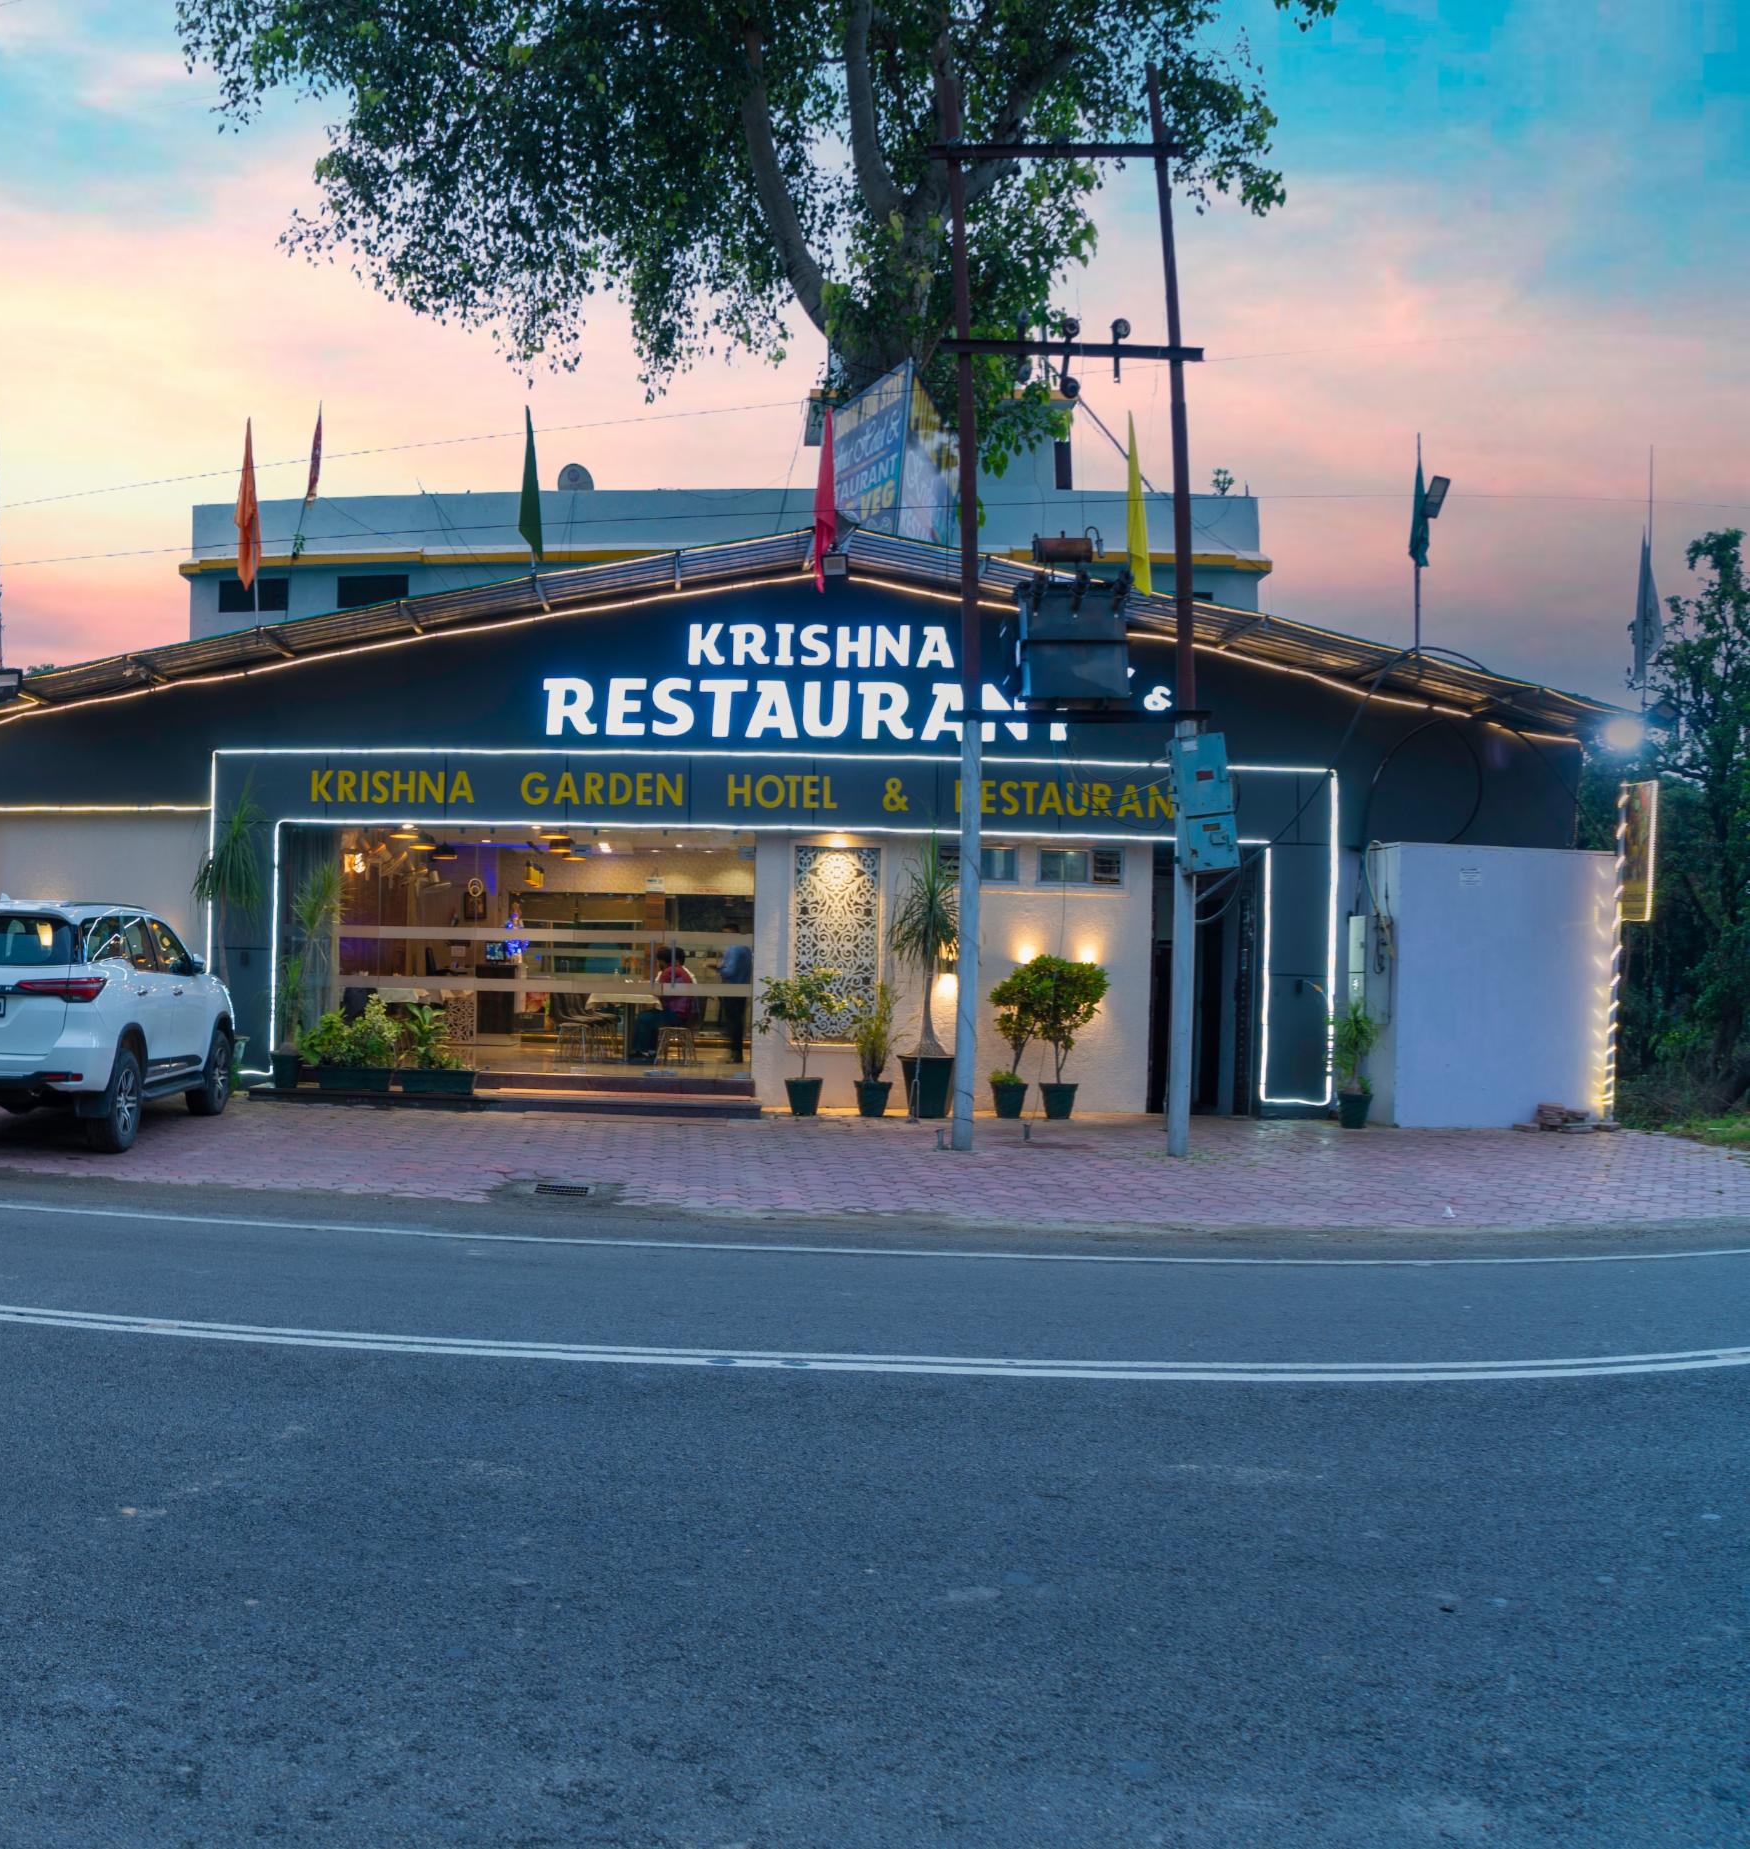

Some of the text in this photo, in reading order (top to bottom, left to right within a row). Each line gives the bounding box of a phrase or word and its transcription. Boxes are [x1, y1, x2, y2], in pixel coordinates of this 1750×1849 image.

[835, 452, 899, 502] TAURANT
[861, 480, 895, 520] VEG
[687, 623, 955, 668] KRISHNA
[1143, 685, 1173, 711] &
[310, 769, 1175, 819] KRISHNA GARDEN HOTEL & ESTAURAN
